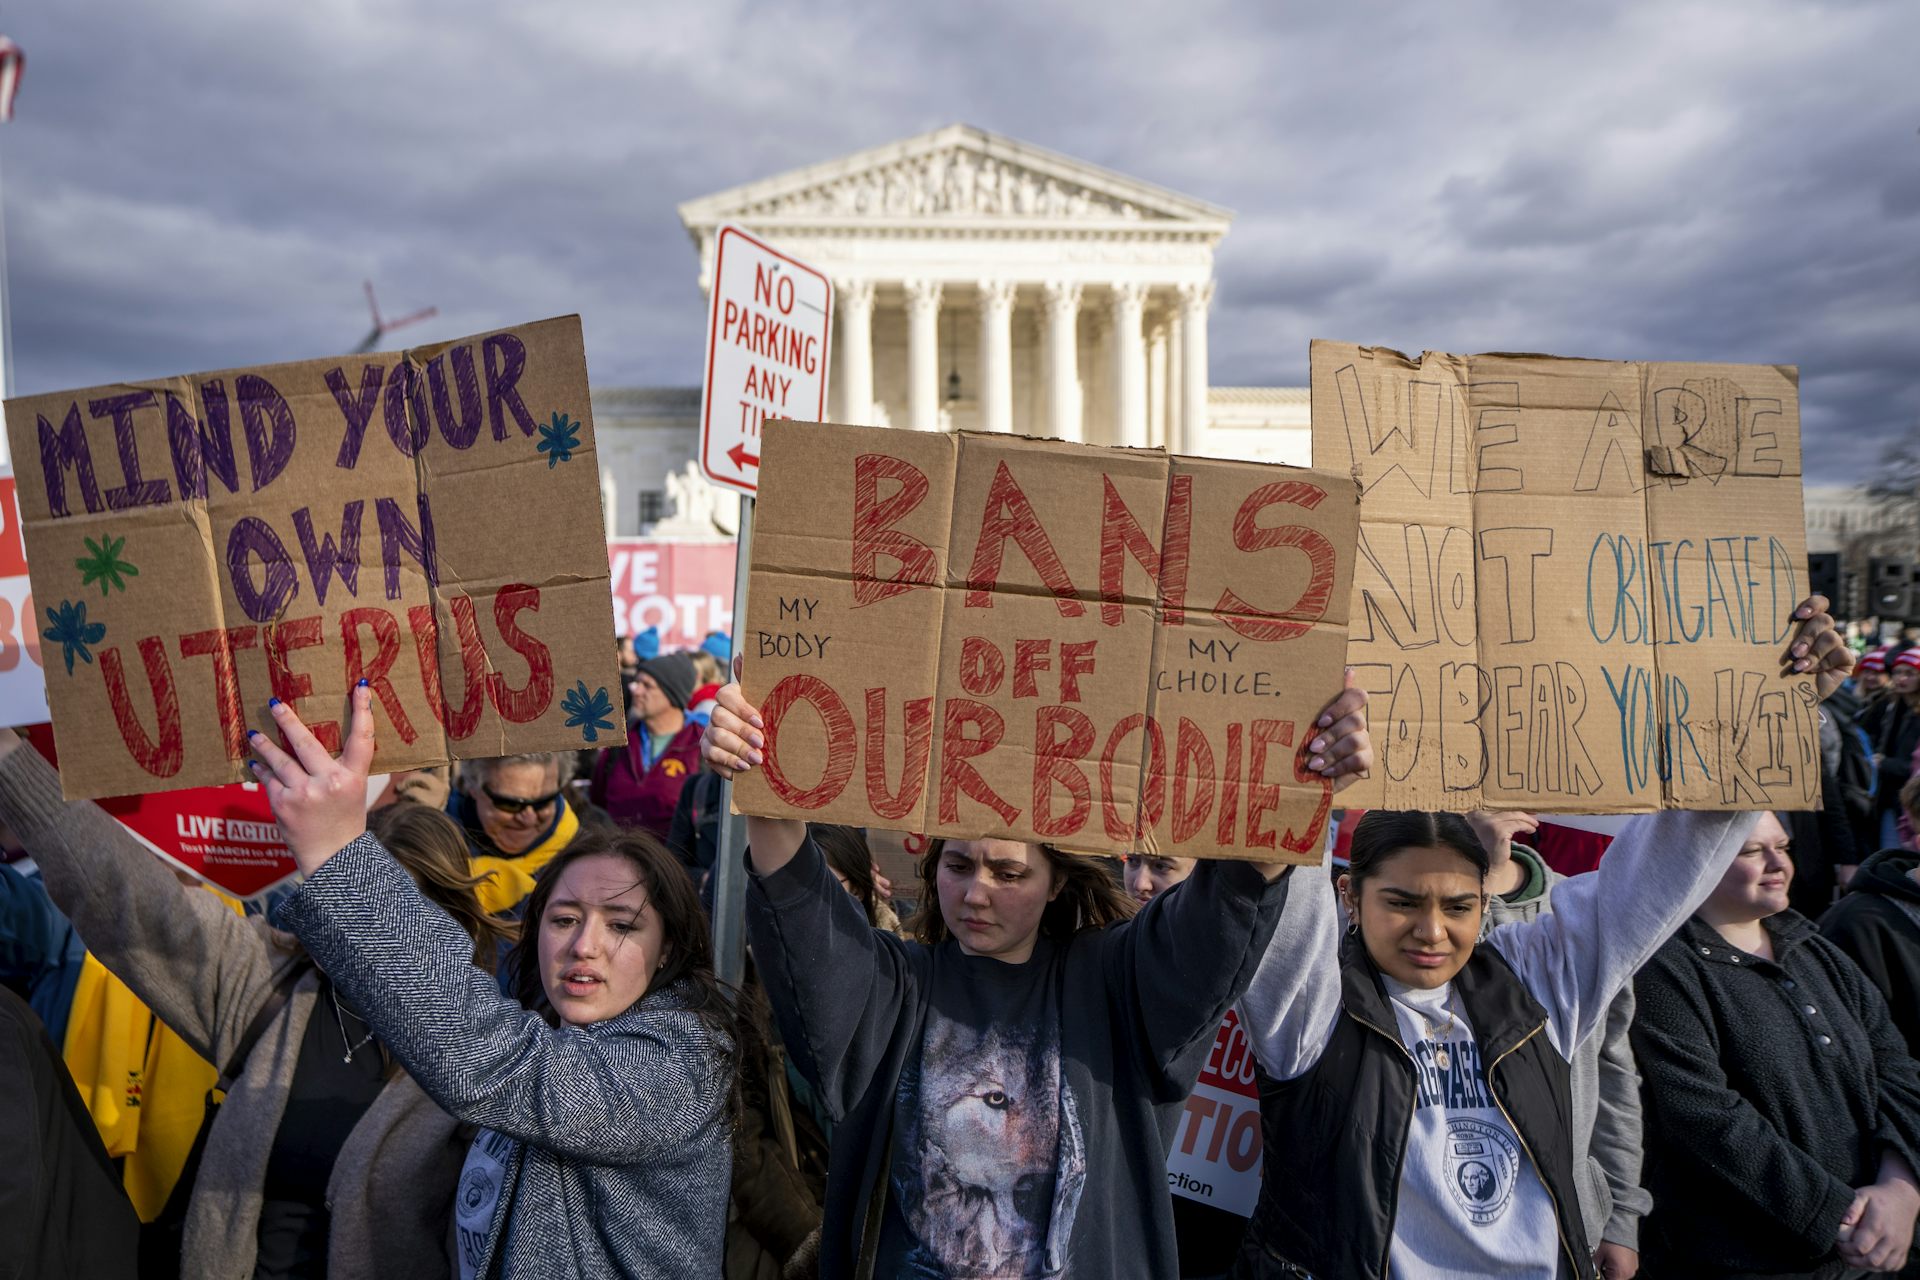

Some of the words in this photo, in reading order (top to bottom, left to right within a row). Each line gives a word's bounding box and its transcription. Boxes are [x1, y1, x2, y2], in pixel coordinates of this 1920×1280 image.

[754, 262, 795, 316] NO
[723, 299, 817, 375] PARKING
[739, 400, 792, 438] TI
[744, 365, 792, 408] ANY
[37, 374, 297, 518] MIND
[324, 333, 537, 470] YOUR
[1336, 365, 1524, 500] WE
[1574, 387, 1782, 492] ARE
[226, 494, 439, 622] OWN
[850, 453, 1337, 642] BANS
[778, 597, 819, 621] MY
[1347, 523, 1554, 651] NOT
[1587, 532, 1797, 647] OBLIGATED
[758, 631, 832, 660] BODY
[959, 635, 1099, 703] OFF
[1188, 638, 1241, 664] MY
[100, 583, 555, 779] UTERUS
[1157, 670, 1282, 697] CHOICE.
[1439, 660, 1604, 797] BEAR
[1600, 663, 1711, 796] YOUR
[759, 673, 1023, 827] OUR
[1032, 704, 1335, 856] BODIES
[176, 813, 225, 841] LIVE
[230, 820, 283, 842] ACTIO
[1168, 1172, 1213, 1197] ction
